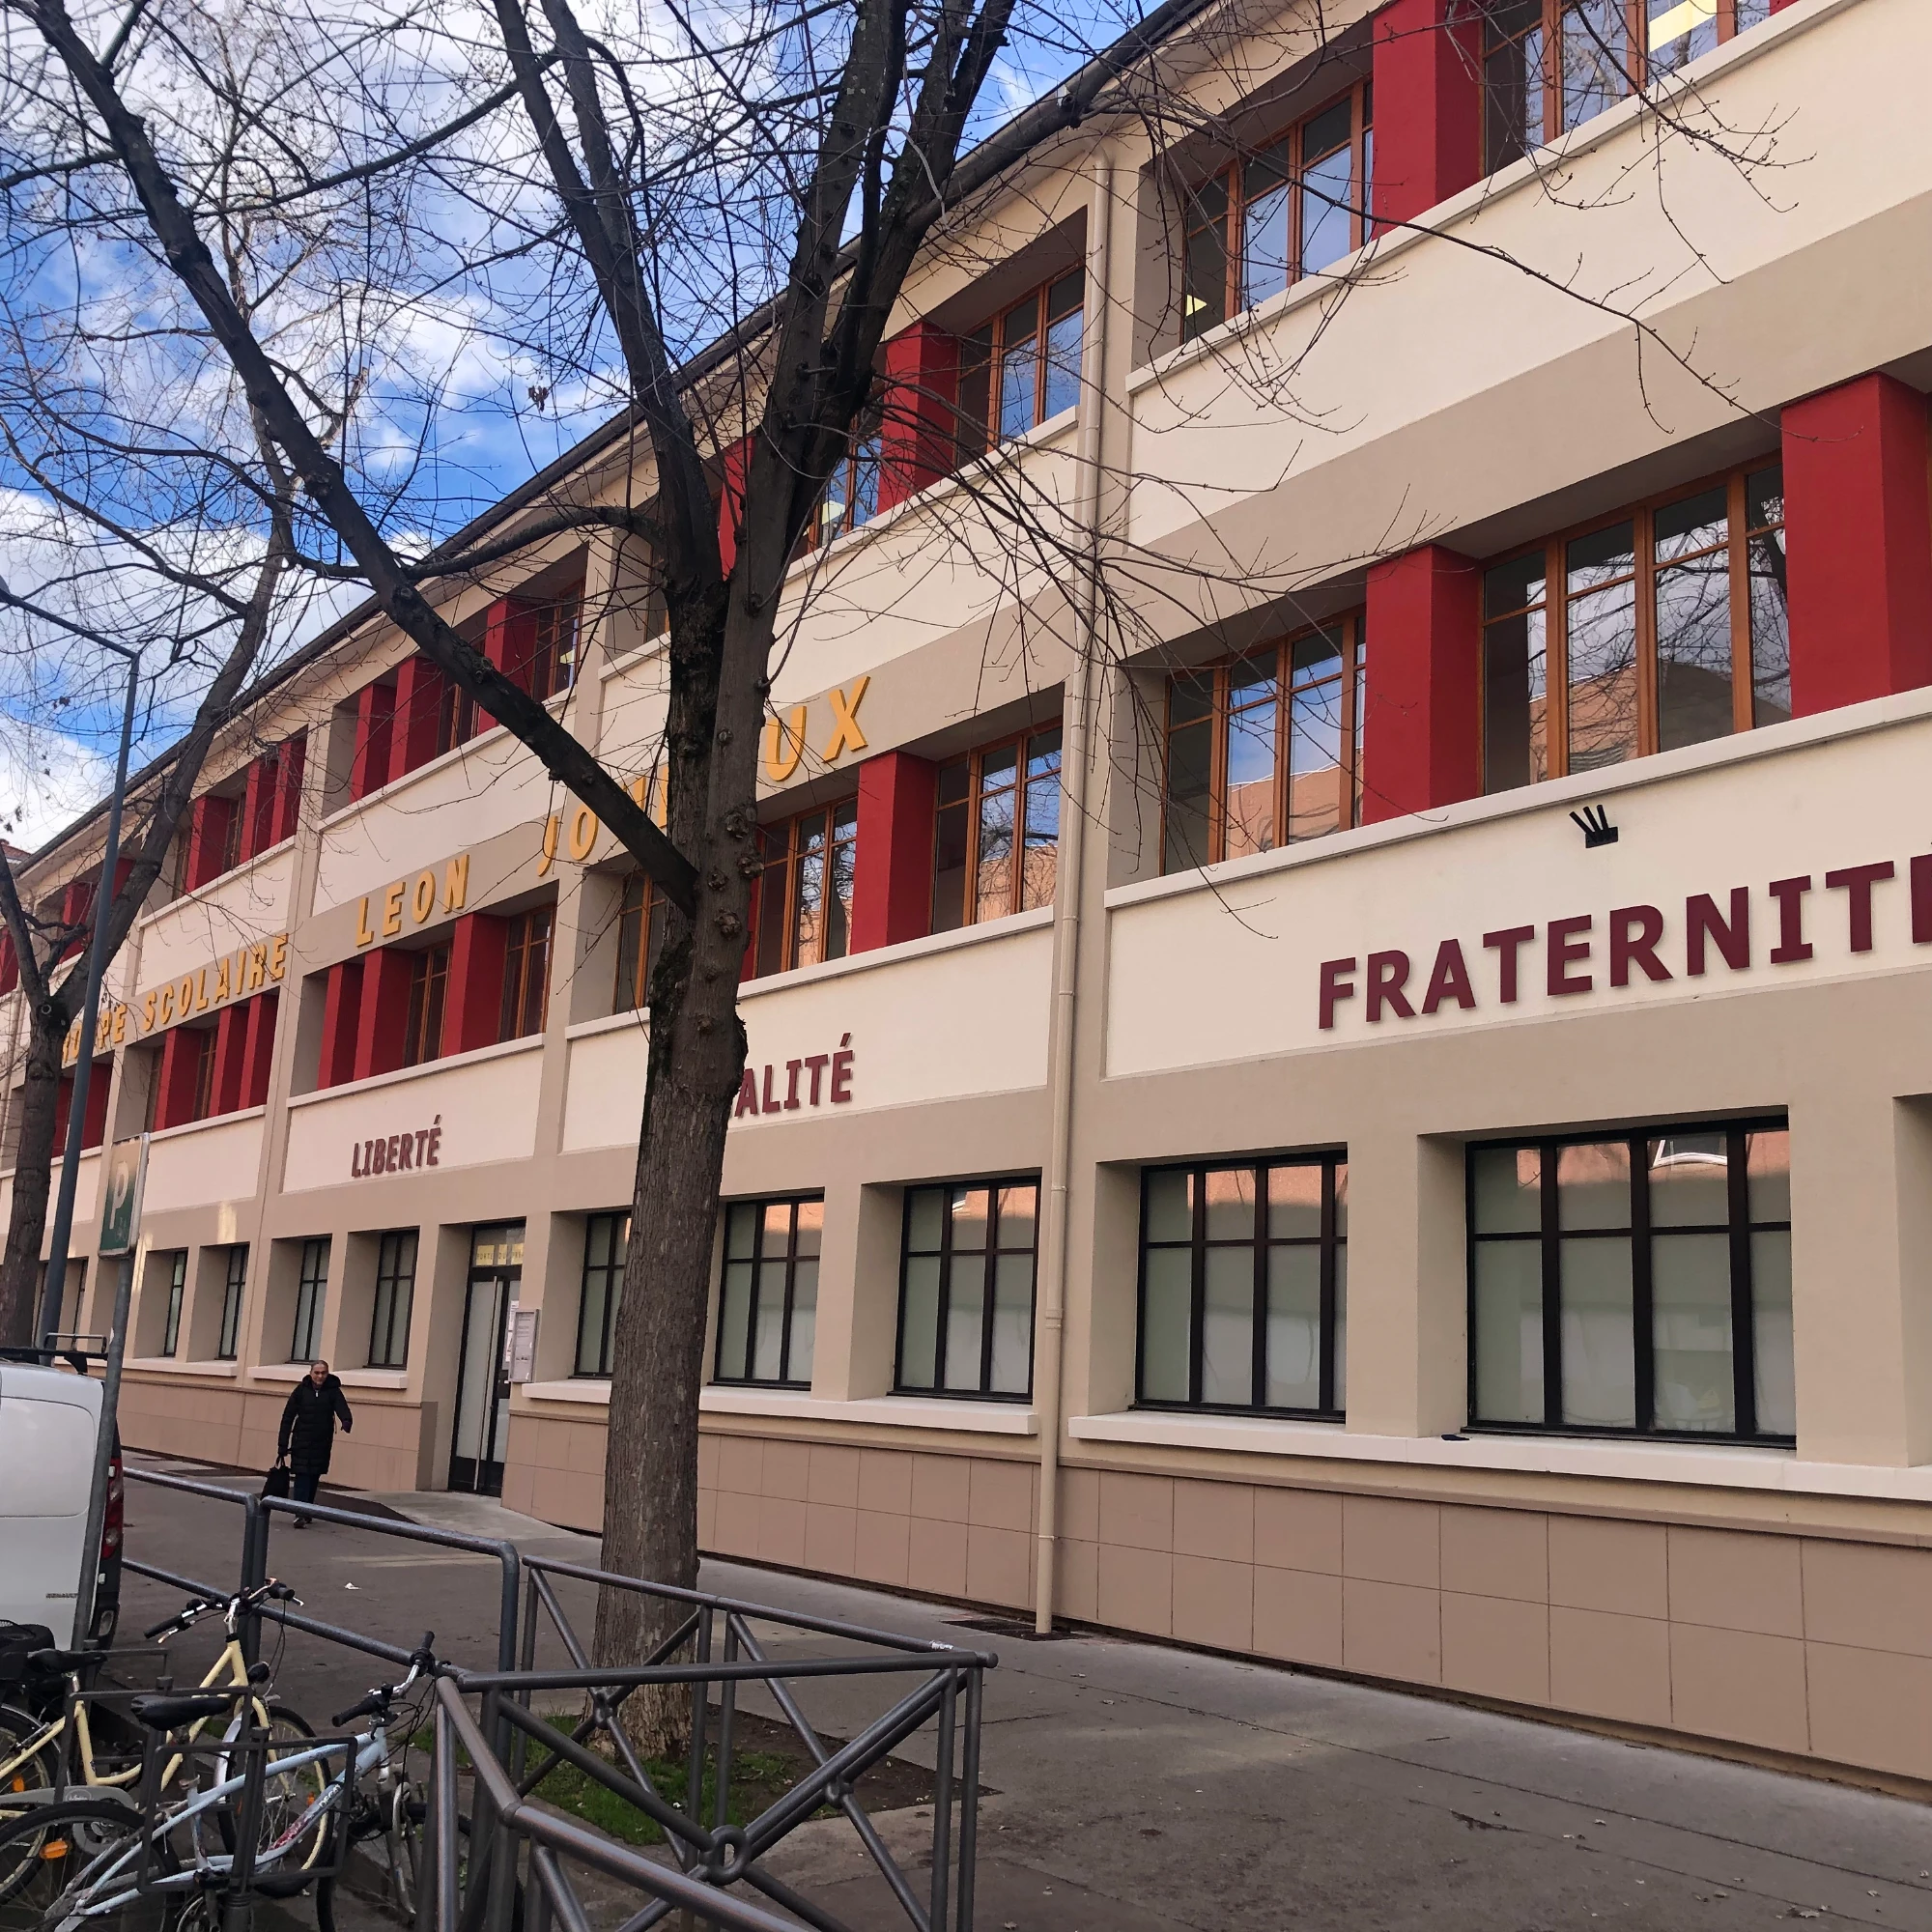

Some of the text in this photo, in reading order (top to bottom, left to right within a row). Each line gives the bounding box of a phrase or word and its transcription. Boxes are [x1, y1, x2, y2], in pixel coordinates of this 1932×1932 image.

[144, 933, 289, 1032] SCOLAIRE
[355, 854, 470, 948] LEON
[537, 676, 870, 877] JOUX
[734, 1032, 853, 1118] ALITÉ
[352, 1114, 441, 1178] LIBERTÉ
[109, 1160, 129, 1230] P
